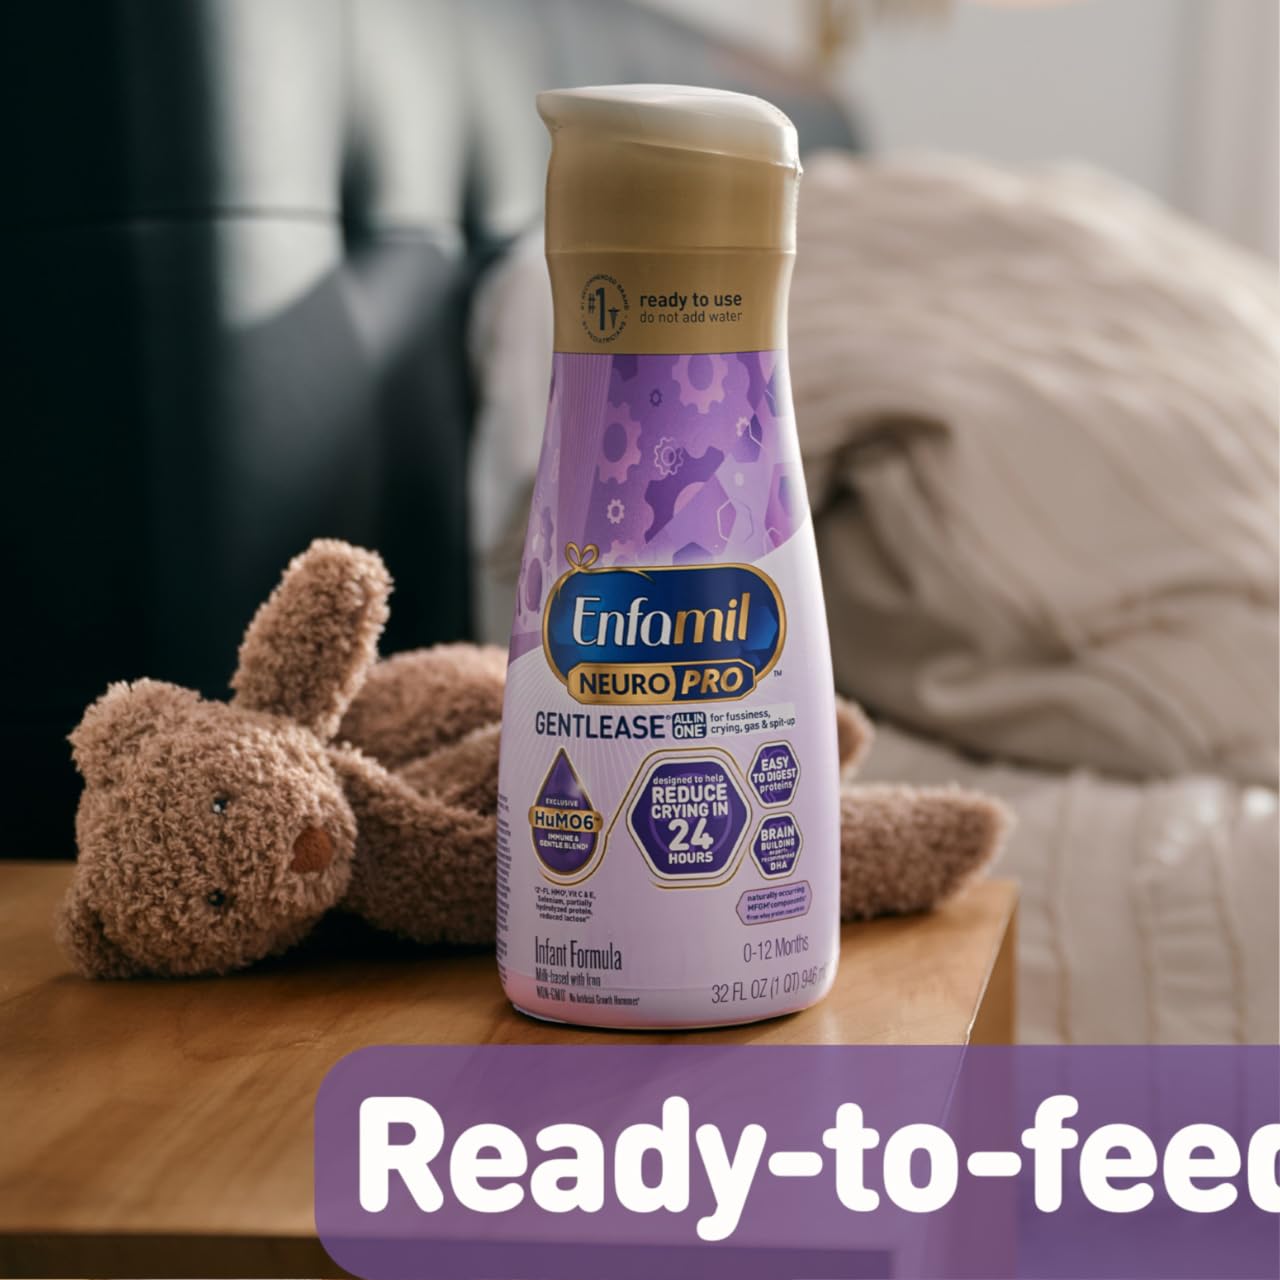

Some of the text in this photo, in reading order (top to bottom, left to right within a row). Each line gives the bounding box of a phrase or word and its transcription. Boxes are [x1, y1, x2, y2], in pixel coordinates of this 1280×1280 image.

[639, 291, 743, 311] ready to use
[639, 311, 743, 323] do not add water
[572, 592, 751, 647] Enfamil
[579, 672, 671, 696] NEURO
[681, 667, 744, 695] PRO
[674, 713, 692, 725] ALL
[693, 713, 705, 724] IN
[710, 710, 771, 722] for fussiness,
[675, 724, 704, 738] ONE
[711, 717, 796, 735] crying, gas & spit-up
[761, 756, 789, 771] EASY
[653, 776, 692, 786] designed
[705, 773, 724, 784] help
[753, 768, 797, 783] TO DIGEST
[652, 783, 728, 803] REDUCE
[760, 781, 792, 794] proteins
[545, 798, 578, 807] EXCLUSIVE
[651, 801, 728, 819] CRYING IN
[548, 833, 573, 842] IMMUNE
[668, 818, 714, 851] 24
[761, 825, 795, 841] BRAIN
[540, 841, 562, 849] GENTLE
[761, 839, 795, 851] BUILDING
[668, 851, 713, 864] HOURS
[770, 862, 787, 871] DHA
[747, 891, 777, 902] naturally
[535, 935, 623, 970] Infant Formula
[743, 934, 809, 963] 0-12 Months
[570, 972, 585, 986] with
[711, 983, 729, 1004] 32
[732, 981, 747, 1002] FL
[751, 978, 768, 999] OZ
[770, 976, 779, 1000] (1
[783, 971, 799, 994] QT)
